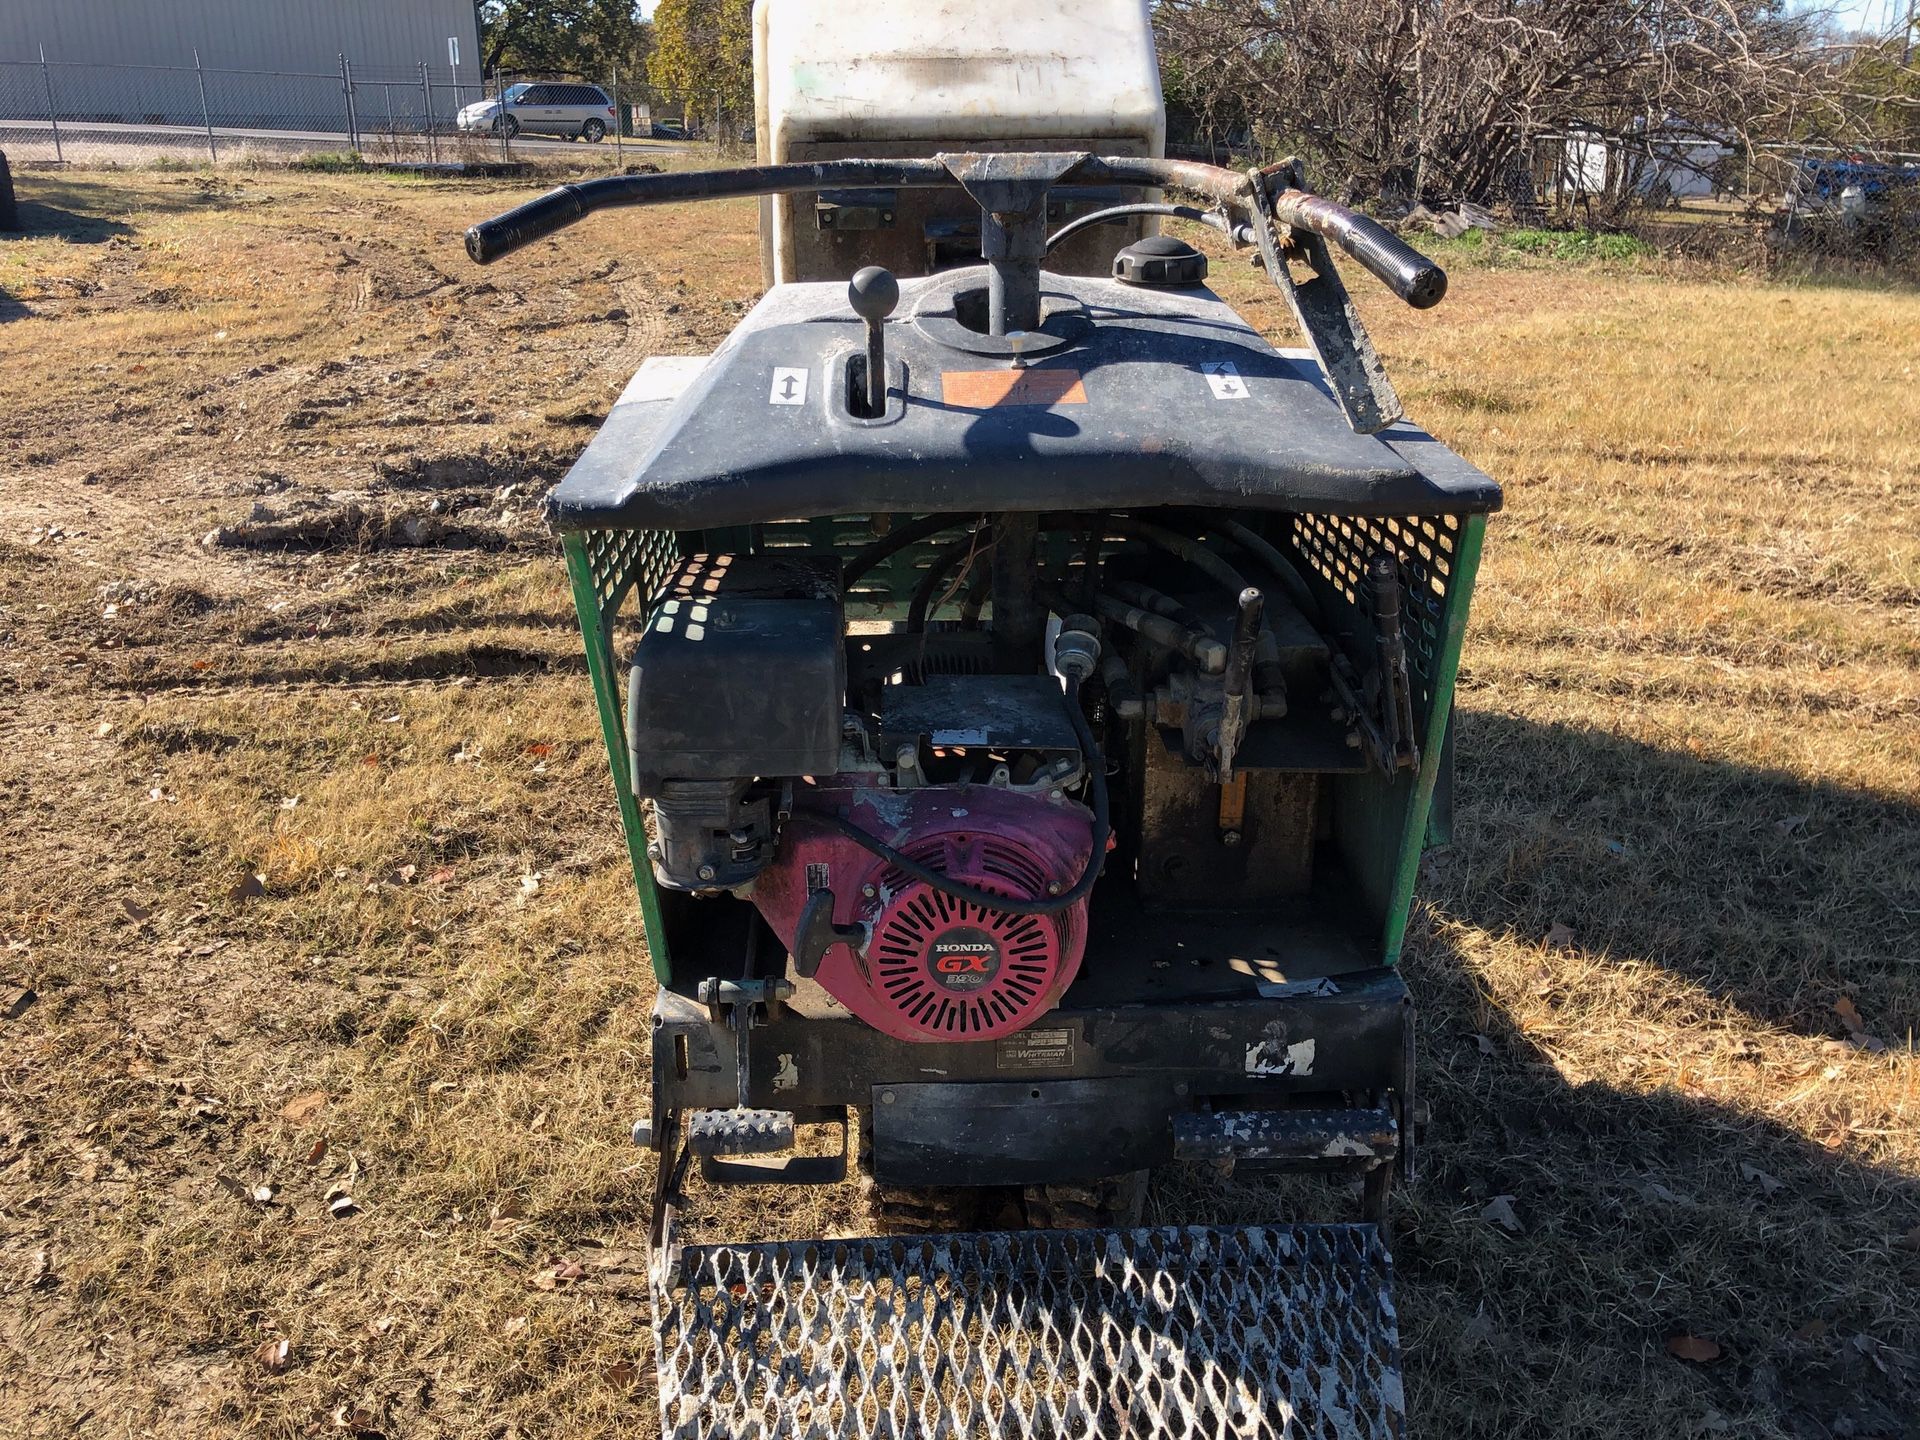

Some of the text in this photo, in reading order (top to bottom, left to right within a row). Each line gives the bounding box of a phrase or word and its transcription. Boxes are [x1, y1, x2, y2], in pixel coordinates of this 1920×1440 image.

[935, 944, 994, 952] HONDA
[937, 955, 991, 973] GX
[946, 974, 982, 984] 390
